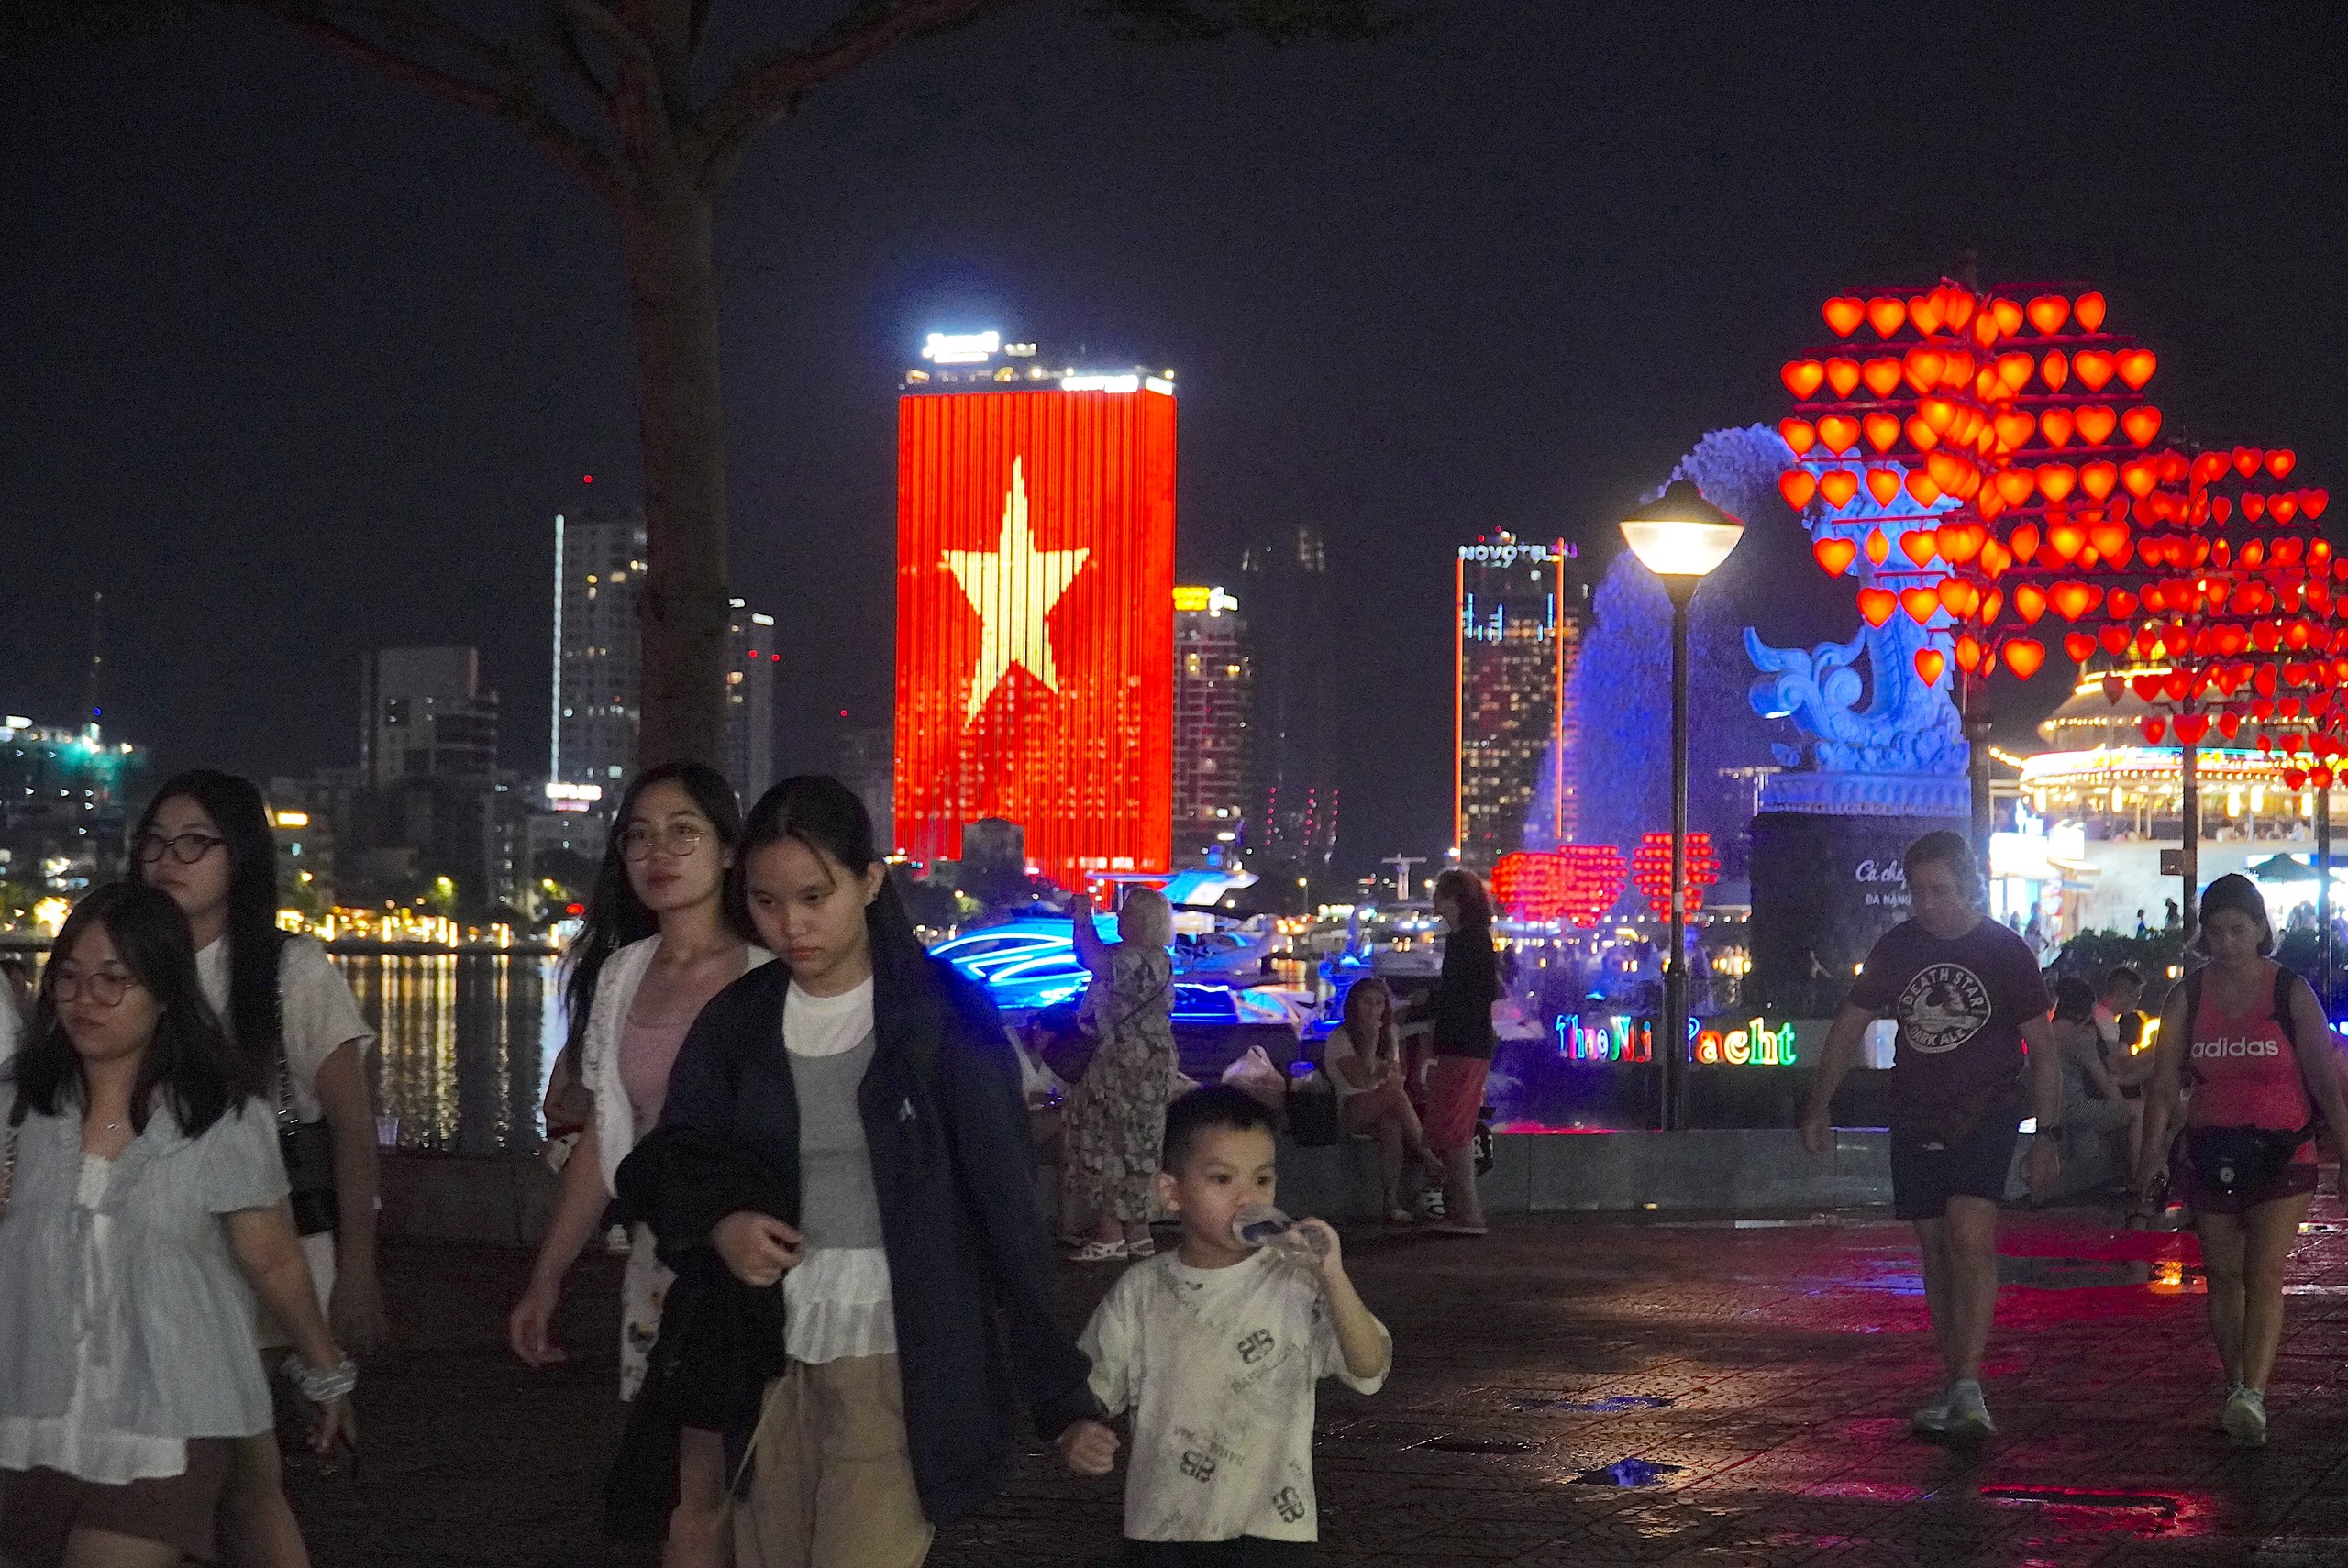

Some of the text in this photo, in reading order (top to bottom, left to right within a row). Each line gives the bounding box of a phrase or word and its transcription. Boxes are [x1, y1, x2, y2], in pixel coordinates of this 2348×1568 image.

[1458, 545, 1551, 561] NOVOTEL
[1903, 967, 1986, 1008] DEATH STAR
[1910, 1026, 1966, 1046] DARK ALE
[2191, 1037, 2279, 1058] adidas
